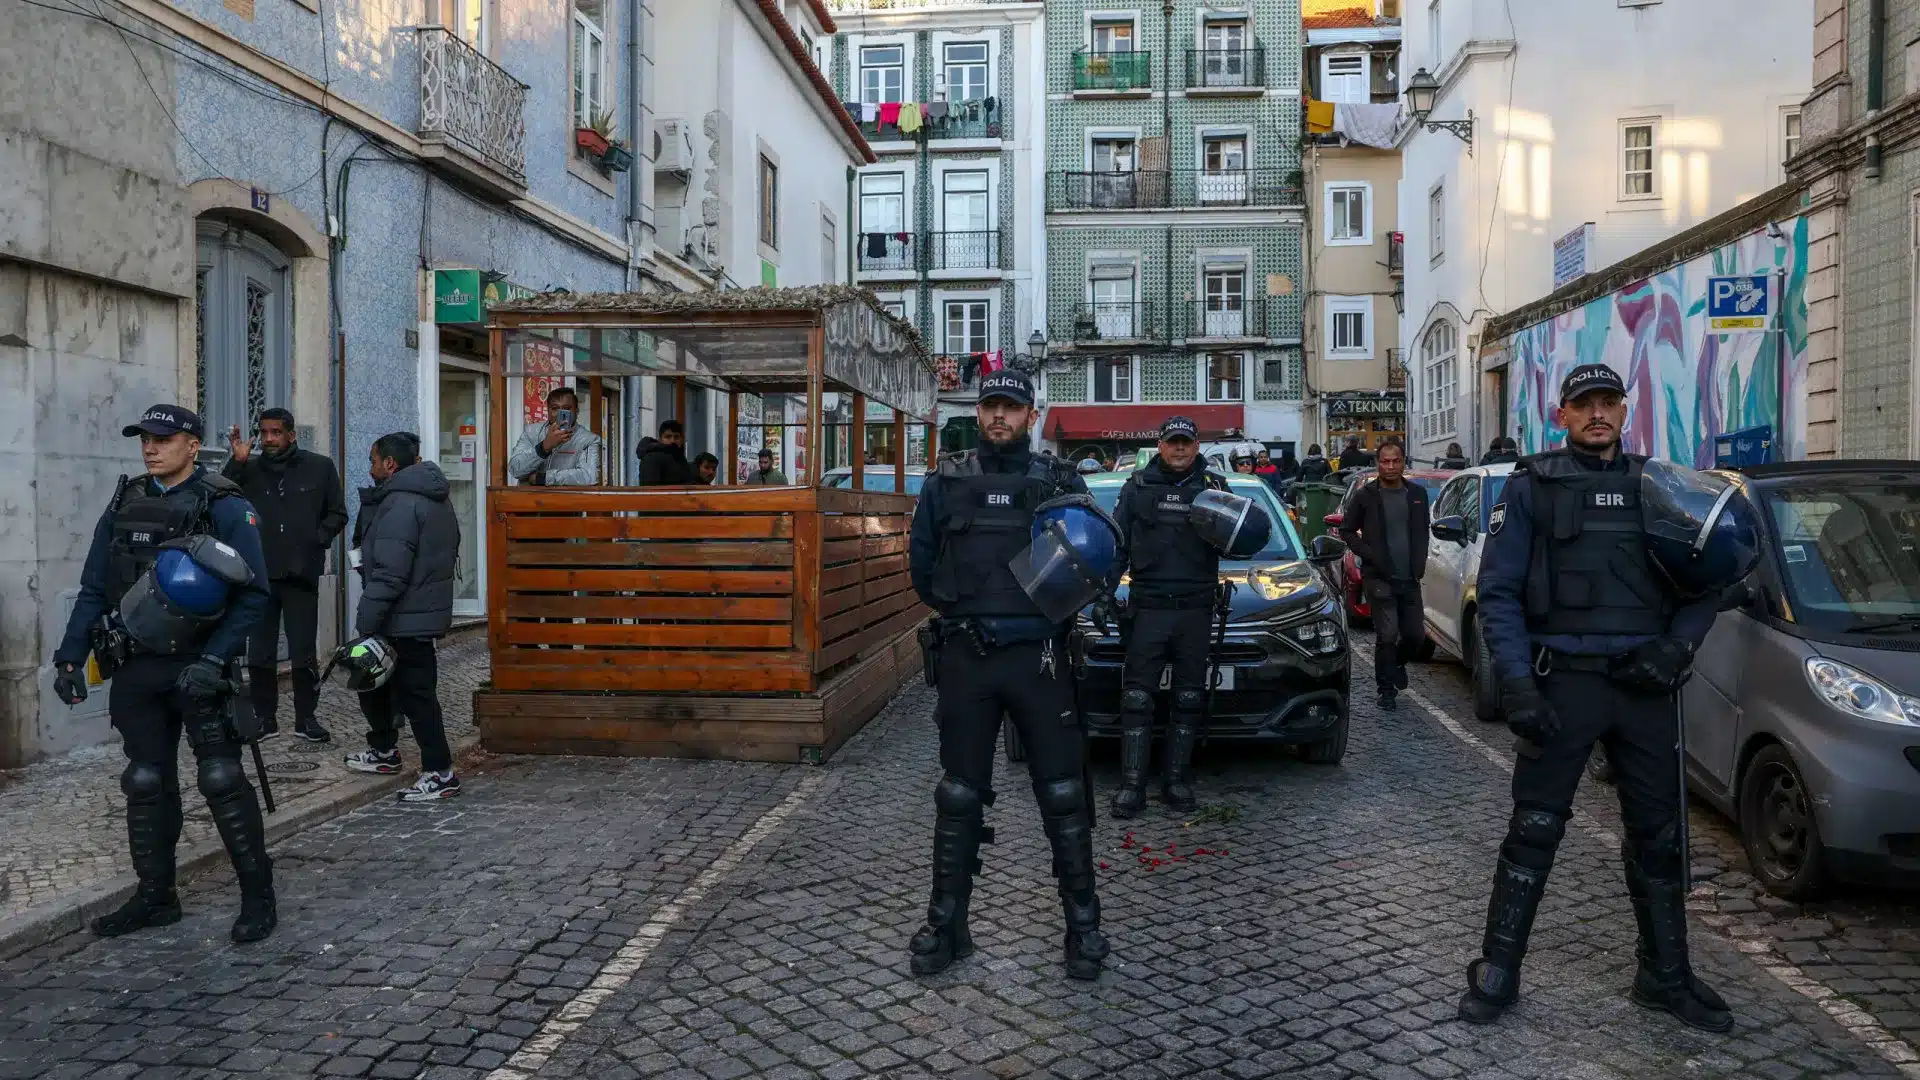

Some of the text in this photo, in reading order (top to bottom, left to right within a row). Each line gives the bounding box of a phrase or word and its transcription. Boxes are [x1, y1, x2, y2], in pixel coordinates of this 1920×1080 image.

[1735, 283, 1753, 291] 038
[1714, 281, 1735, 308] P
[982, 376, 1025, 391] POLÍCIA
[1569, 368, 1620, 386] POLÍCIA
[1348, 400, 1393, 413] TEKNIK
[987, 494, 1010, 505] EIR
[1166, 494, 1181, 502] EIR
[1595, 493, 1625, 506] EIR
[1489, 509, 1504, 524] EIR
[132, 531, 151, 543] EIR
